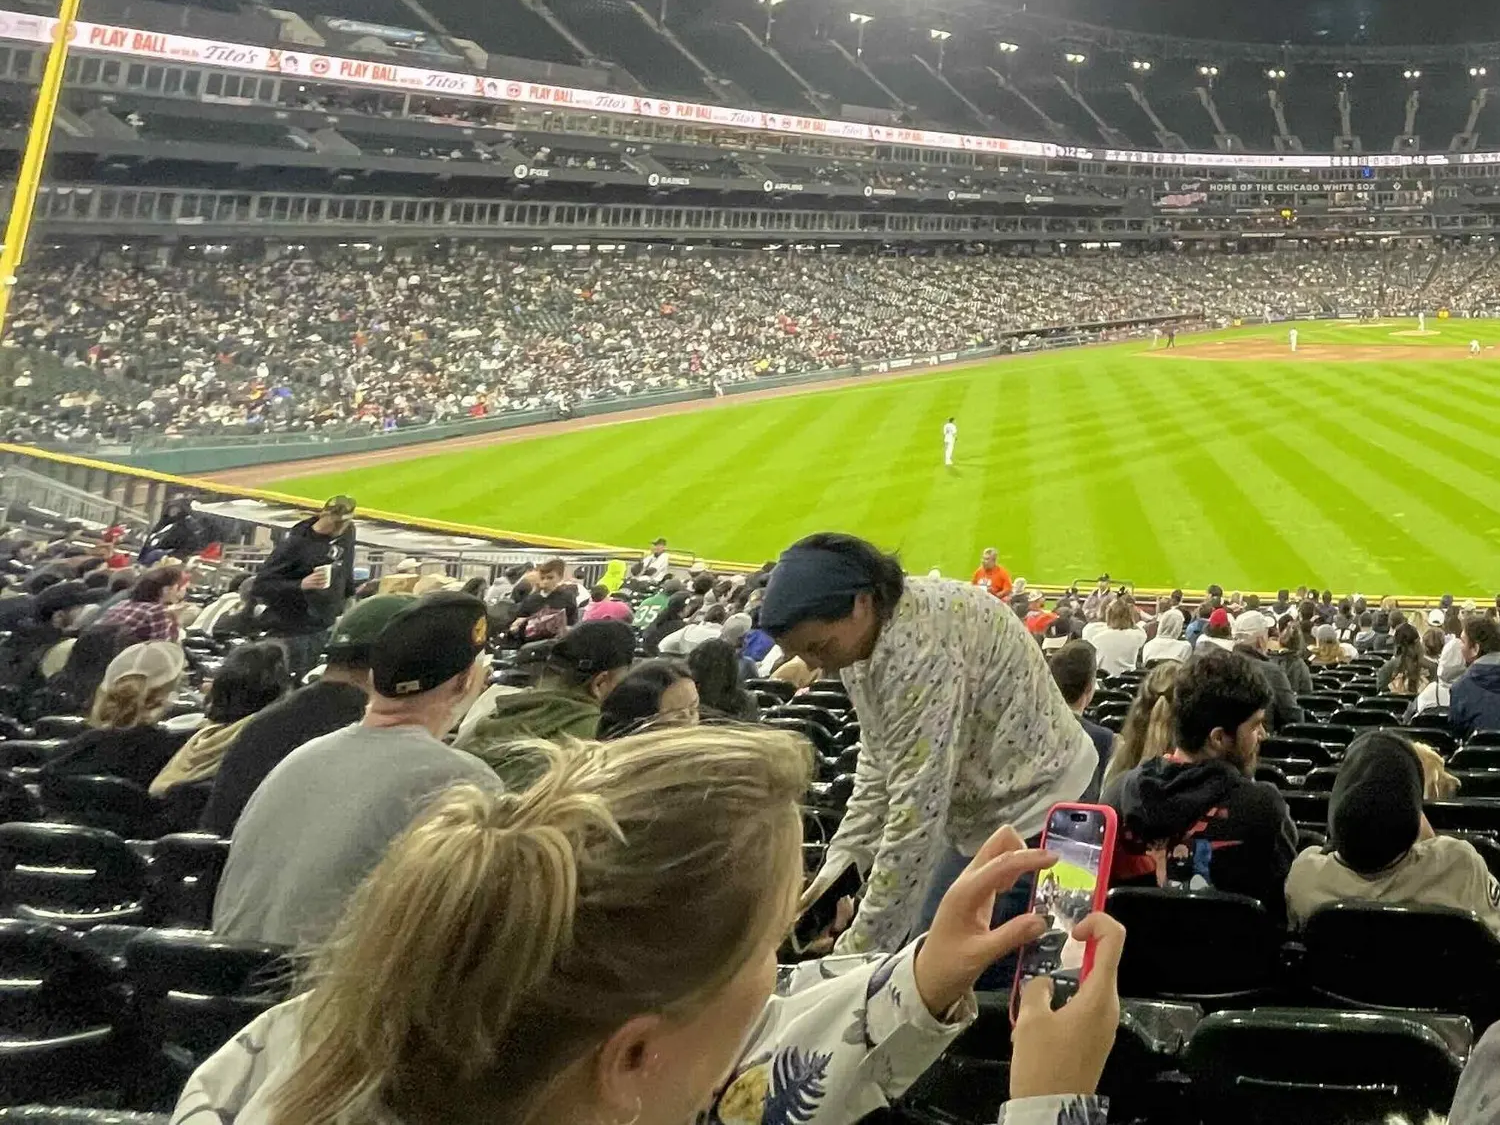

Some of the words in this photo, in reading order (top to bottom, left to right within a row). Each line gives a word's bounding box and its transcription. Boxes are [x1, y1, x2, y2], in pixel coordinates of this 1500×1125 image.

[89, 27, 128, 48] PLAY
[132, 32, 167, 53] BALL
[203, 45, 258, 64] Tito's
[340, 61, 368, 79] PLAY
[372, 65, 397, 82] BALL
[425, 74, 468, 90] Tito's
[529, 85, 551, 100] PLAY
[553, 89, 574, 103] BALL
[1209, 183, 1237, 191] HOME
[1240, 183, 1251, 191] OF
[1256, 183, 1274, 191] THE
[1277, 183, 1320, 191] CHICAGO
[1322, 183, 1354, 191] WHITE
[1356, 183, 1376, 191] SOX
